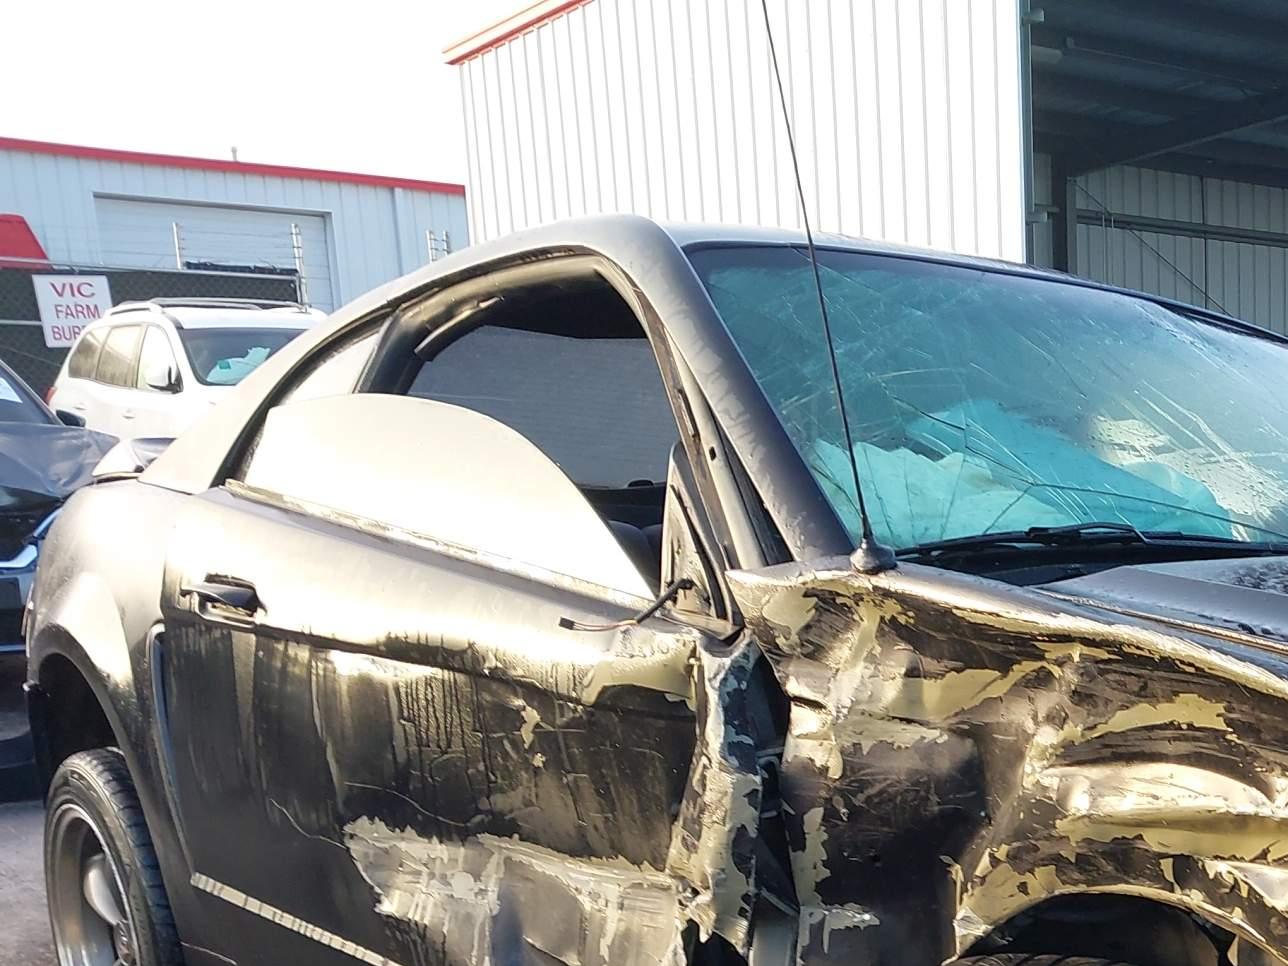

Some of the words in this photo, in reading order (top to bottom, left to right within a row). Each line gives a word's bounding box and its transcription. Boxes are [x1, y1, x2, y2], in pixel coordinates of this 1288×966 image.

[50, 282, 96, 298] VIC
[54, 303, 101, 319] FARM
[51, 325, 87, 341] BUR
